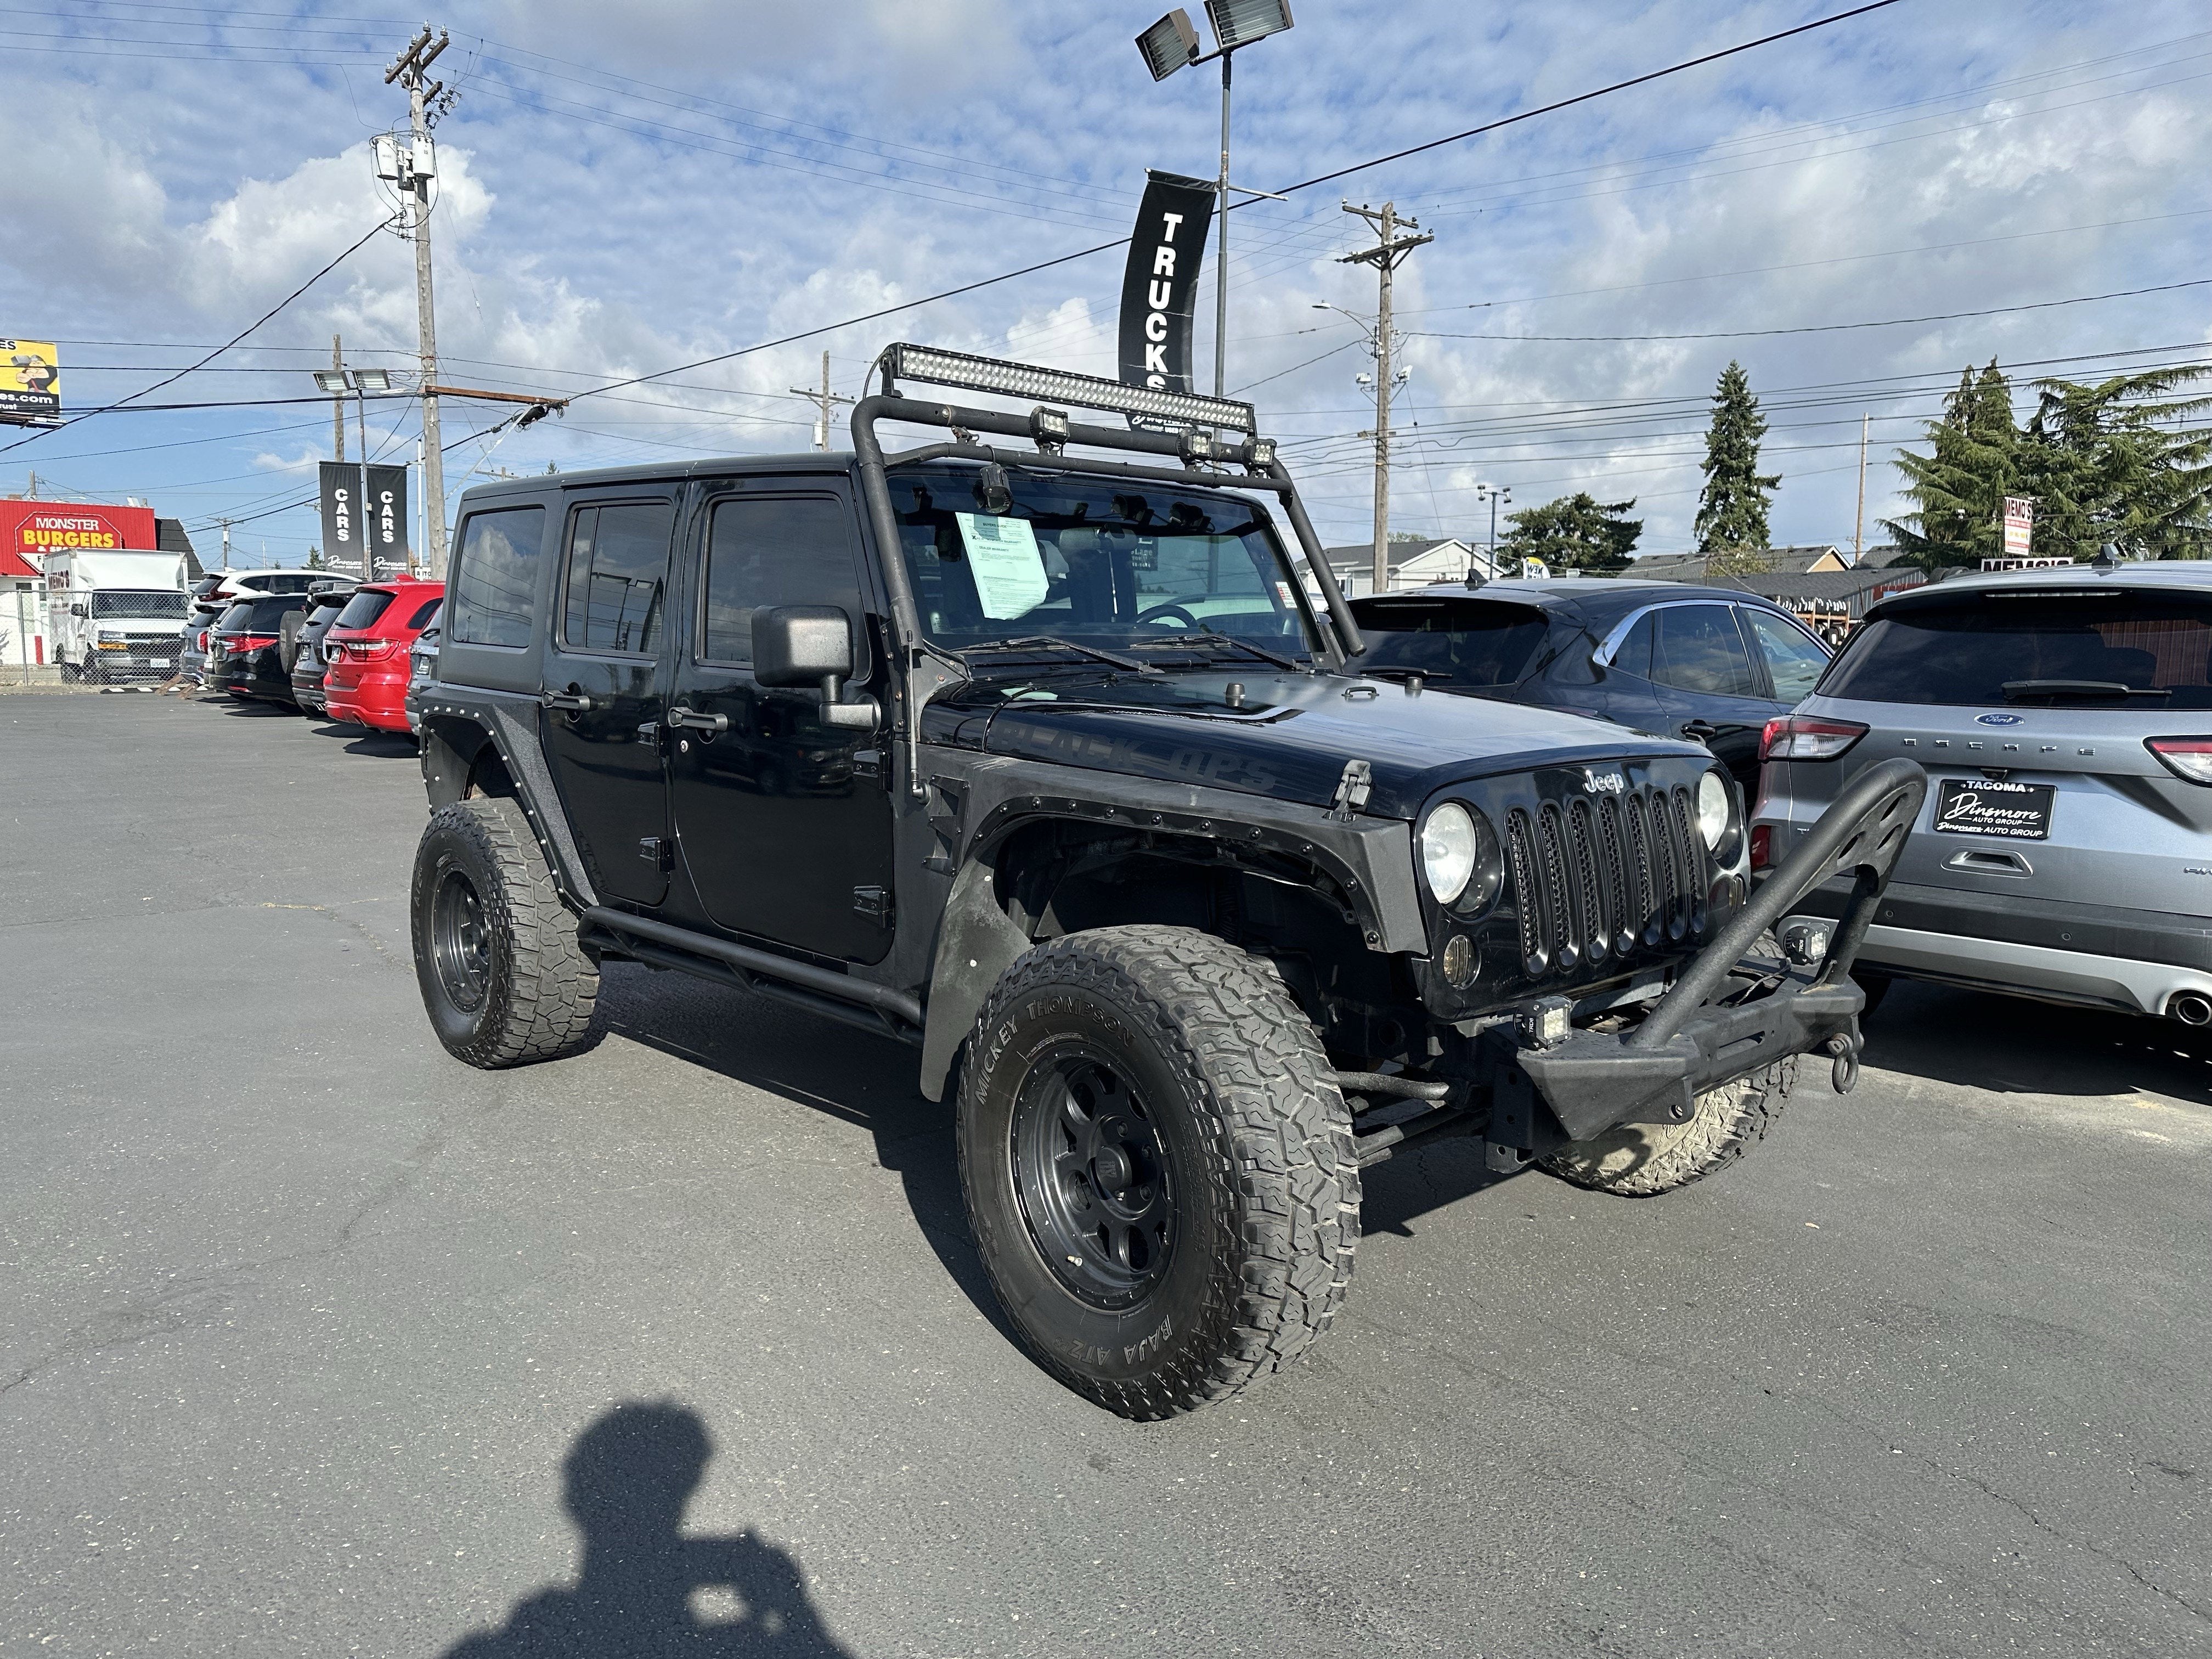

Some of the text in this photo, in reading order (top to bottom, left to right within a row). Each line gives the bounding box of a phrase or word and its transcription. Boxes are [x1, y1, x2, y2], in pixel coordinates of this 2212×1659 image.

[335, 489, 349, 541] CARS
[380, 491, 394, 543] CARS
[2005, 498, 2032, 520] MEMO'S
[36, 517, 99, 531] MONSTER
[23, 530, 114, 548] BURGERS
[990, 722, 1282, 792] BLACK OPS
[1582, 770, 1624, 794] Jeep
[1966, 780, 2026, 793] TACOMA
[1944, 792, 2041, 820] Dinsmore
[1983, 826, 2009, 834] AUTO
[2010, 828, 2043, 837] GROUP
[974, 996, 1136, 1105] MICKEY THOMPSON
[1068, 1338, 1112, 1366] ATZ
[1123, 1314, 1173, 1365] BAJA
